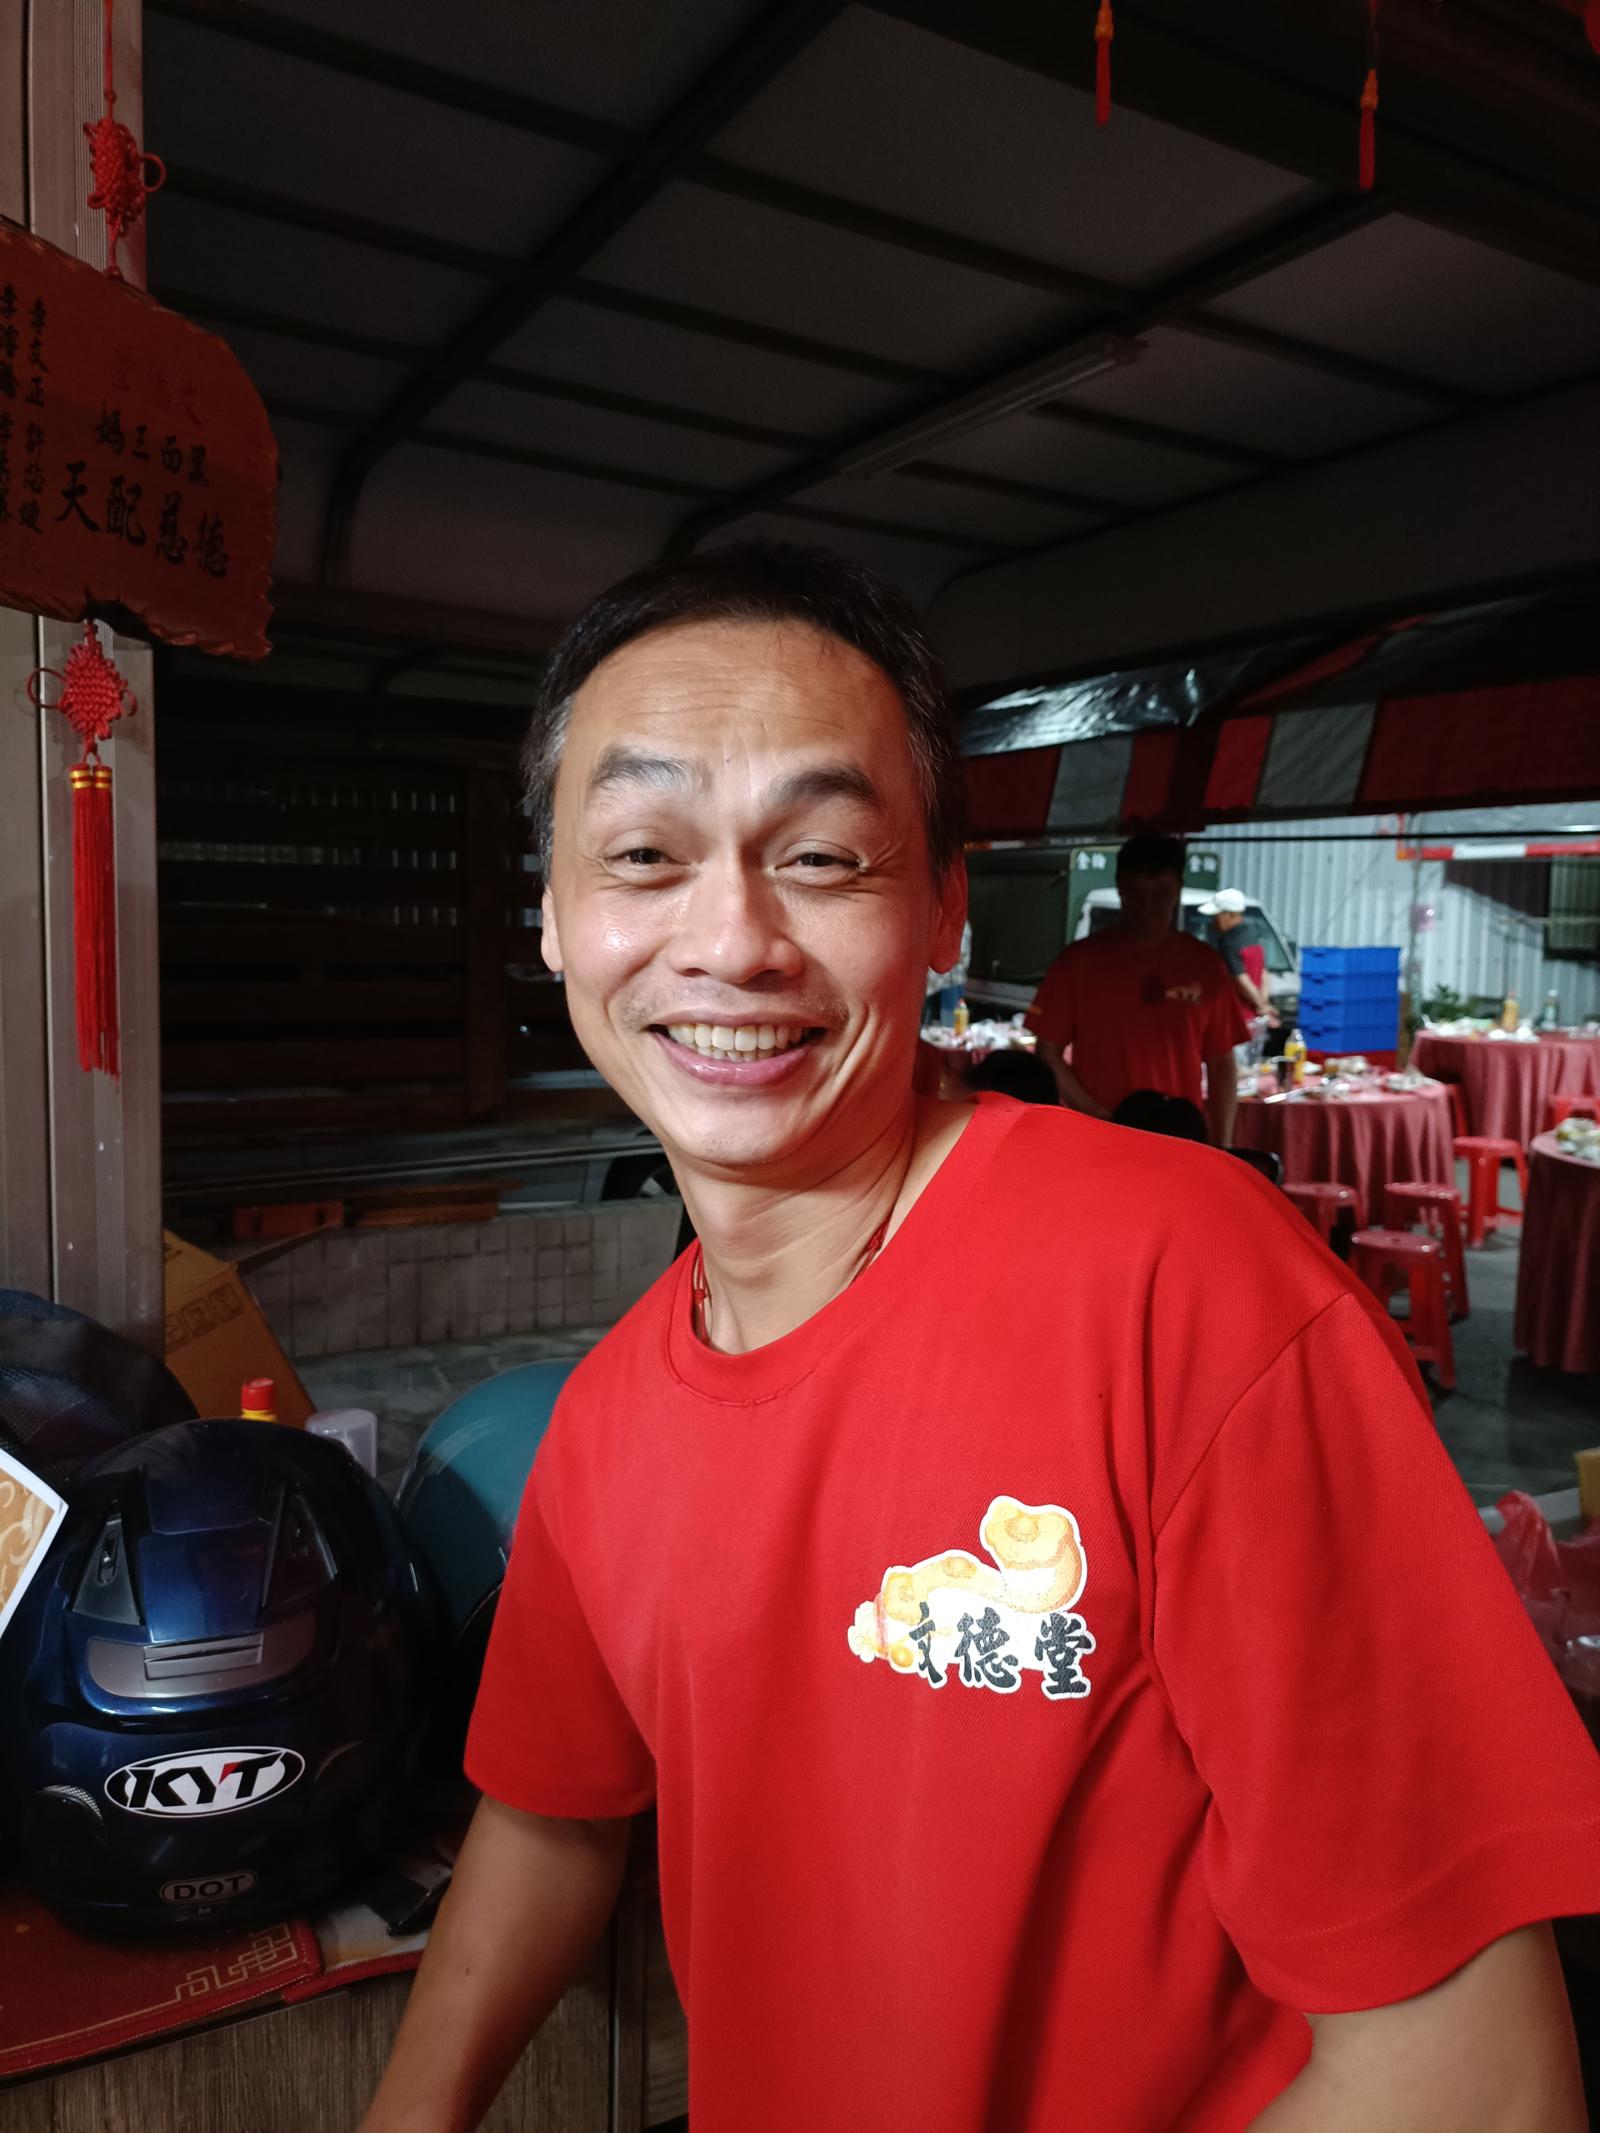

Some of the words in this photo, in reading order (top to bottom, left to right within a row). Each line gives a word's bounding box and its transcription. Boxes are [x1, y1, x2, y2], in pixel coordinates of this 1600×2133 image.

[909, 1601, 1094, 1695] 文德堂
[128, 1751, 284, 1808] KYT
[174, 1874, 245, 1900] DOT
